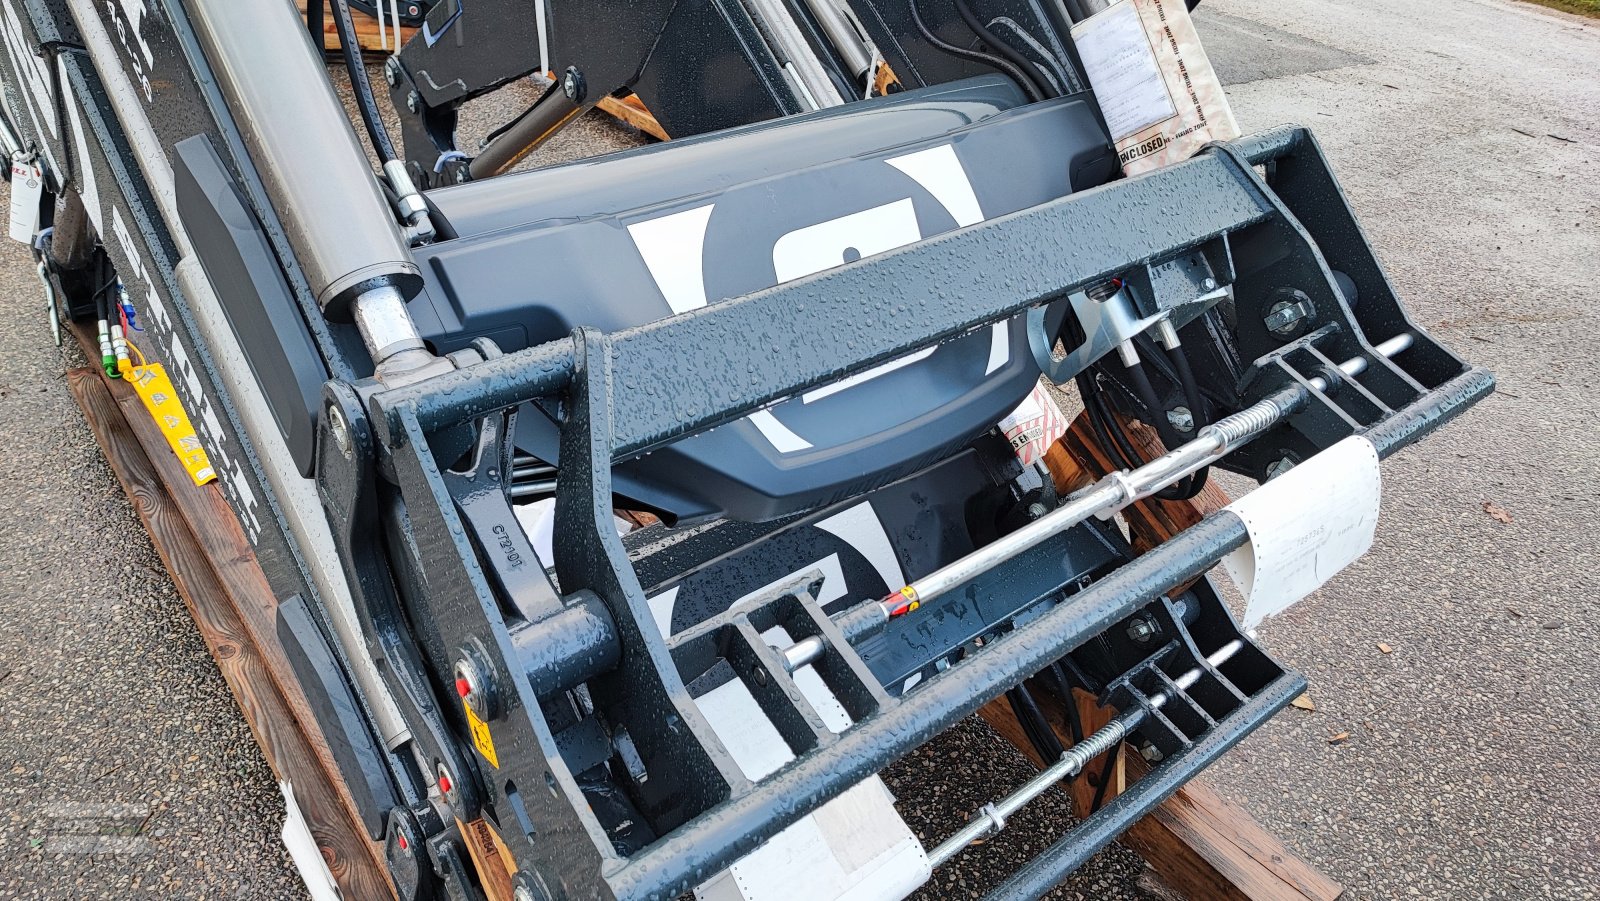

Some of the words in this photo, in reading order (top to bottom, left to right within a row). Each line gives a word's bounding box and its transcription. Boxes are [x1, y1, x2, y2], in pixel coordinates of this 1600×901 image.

[113, 204, 262, 534] STOLL
[146, 307, 197, 418] ProfiLine
[200, 422, 218, 461] FZ
